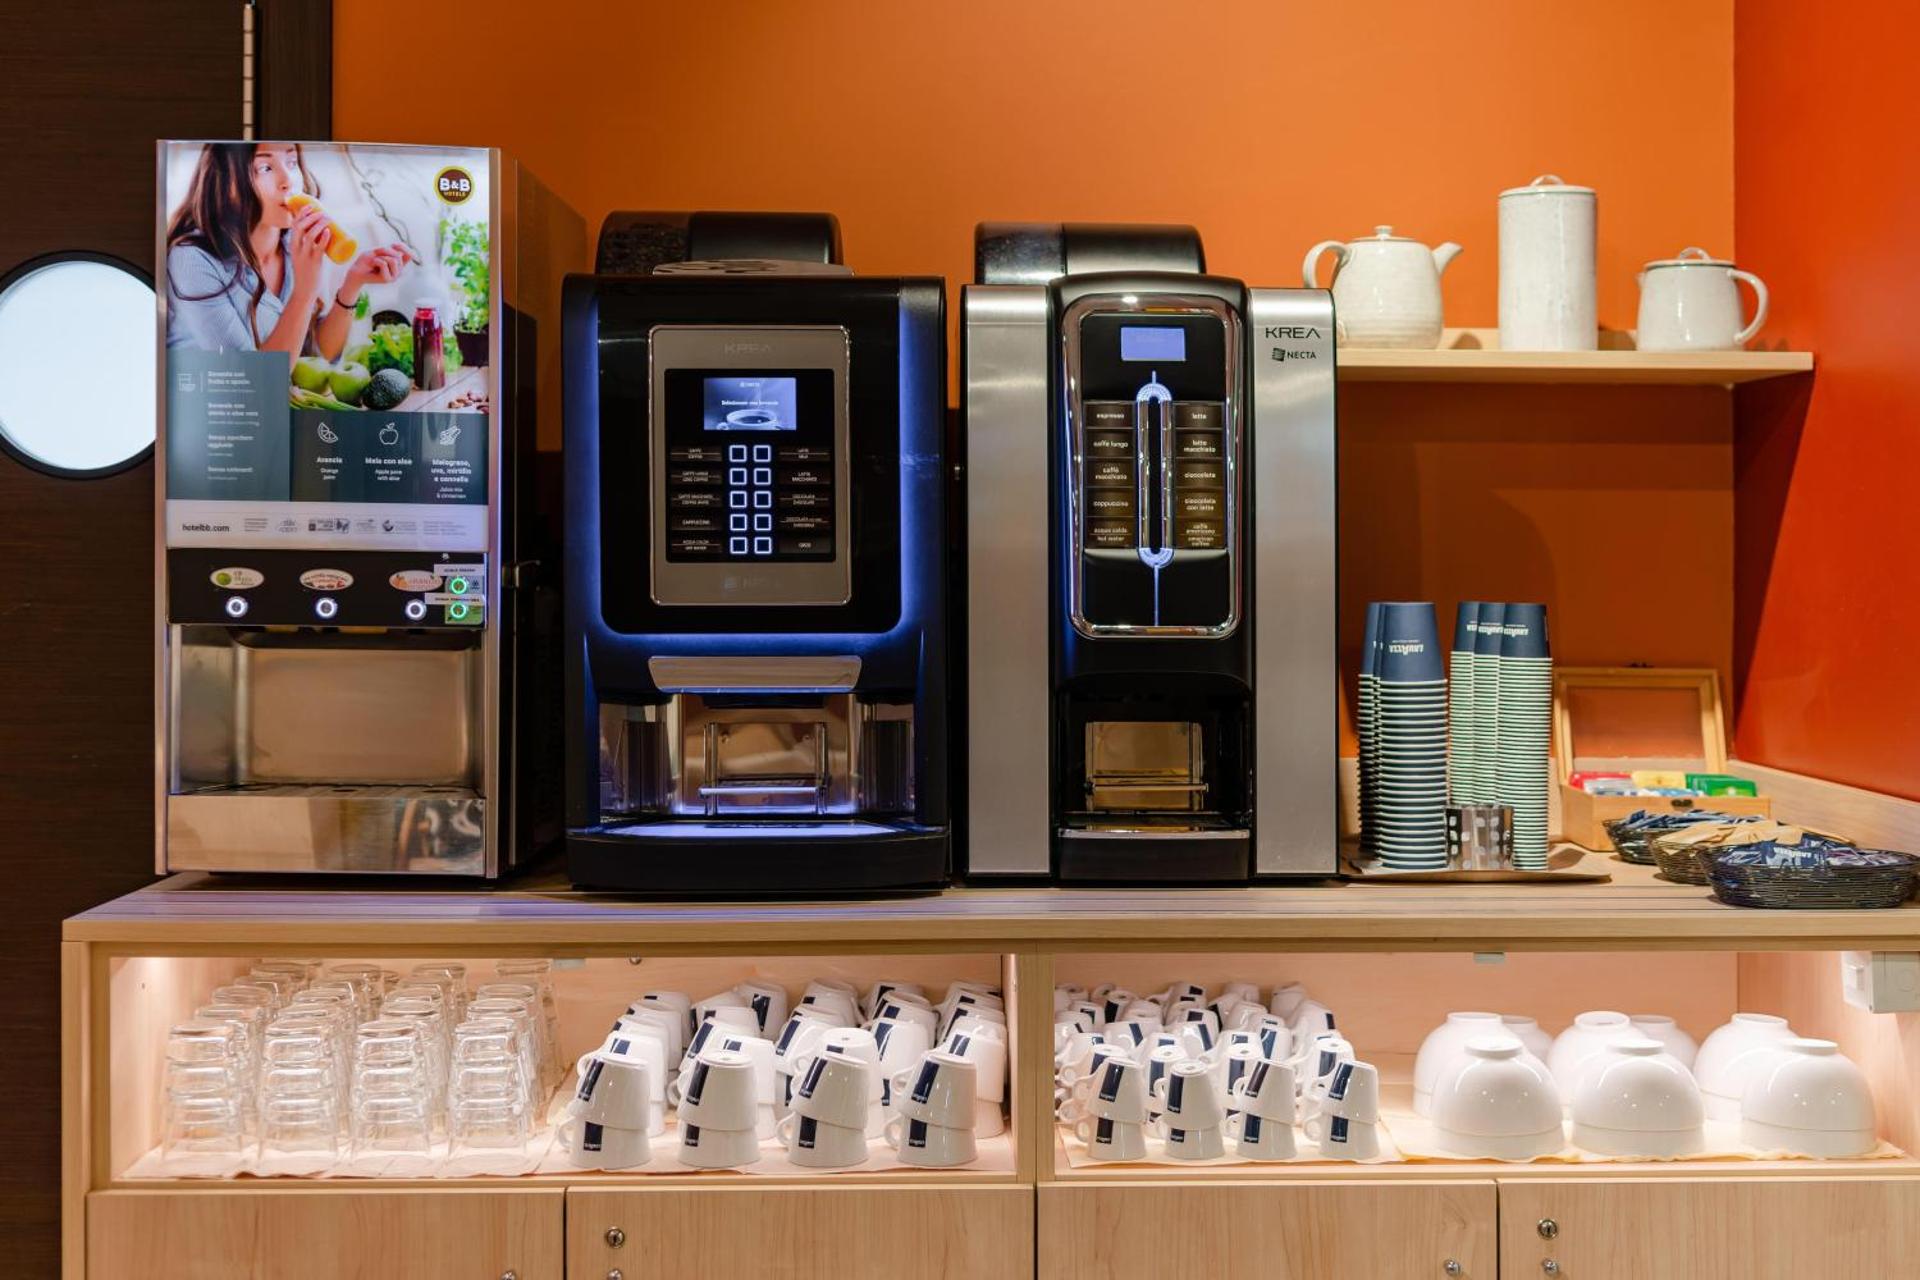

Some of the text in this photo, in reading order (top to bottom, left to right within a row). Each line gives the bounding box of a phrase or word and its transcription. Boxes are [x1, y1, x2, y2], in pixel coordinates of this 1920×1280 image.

[440, 177, 471, 192] B&B
[1265, 327, 1321, 339] KREA
[1287, 351, 1317, 359] NECTA
[316, 456, 343, 464] Arancia
[365, 457, 382, 465] Mela
[182, 521, 230, 532] hotelbb.com
[1389, 644, 1424, 656] LAVAZZA
